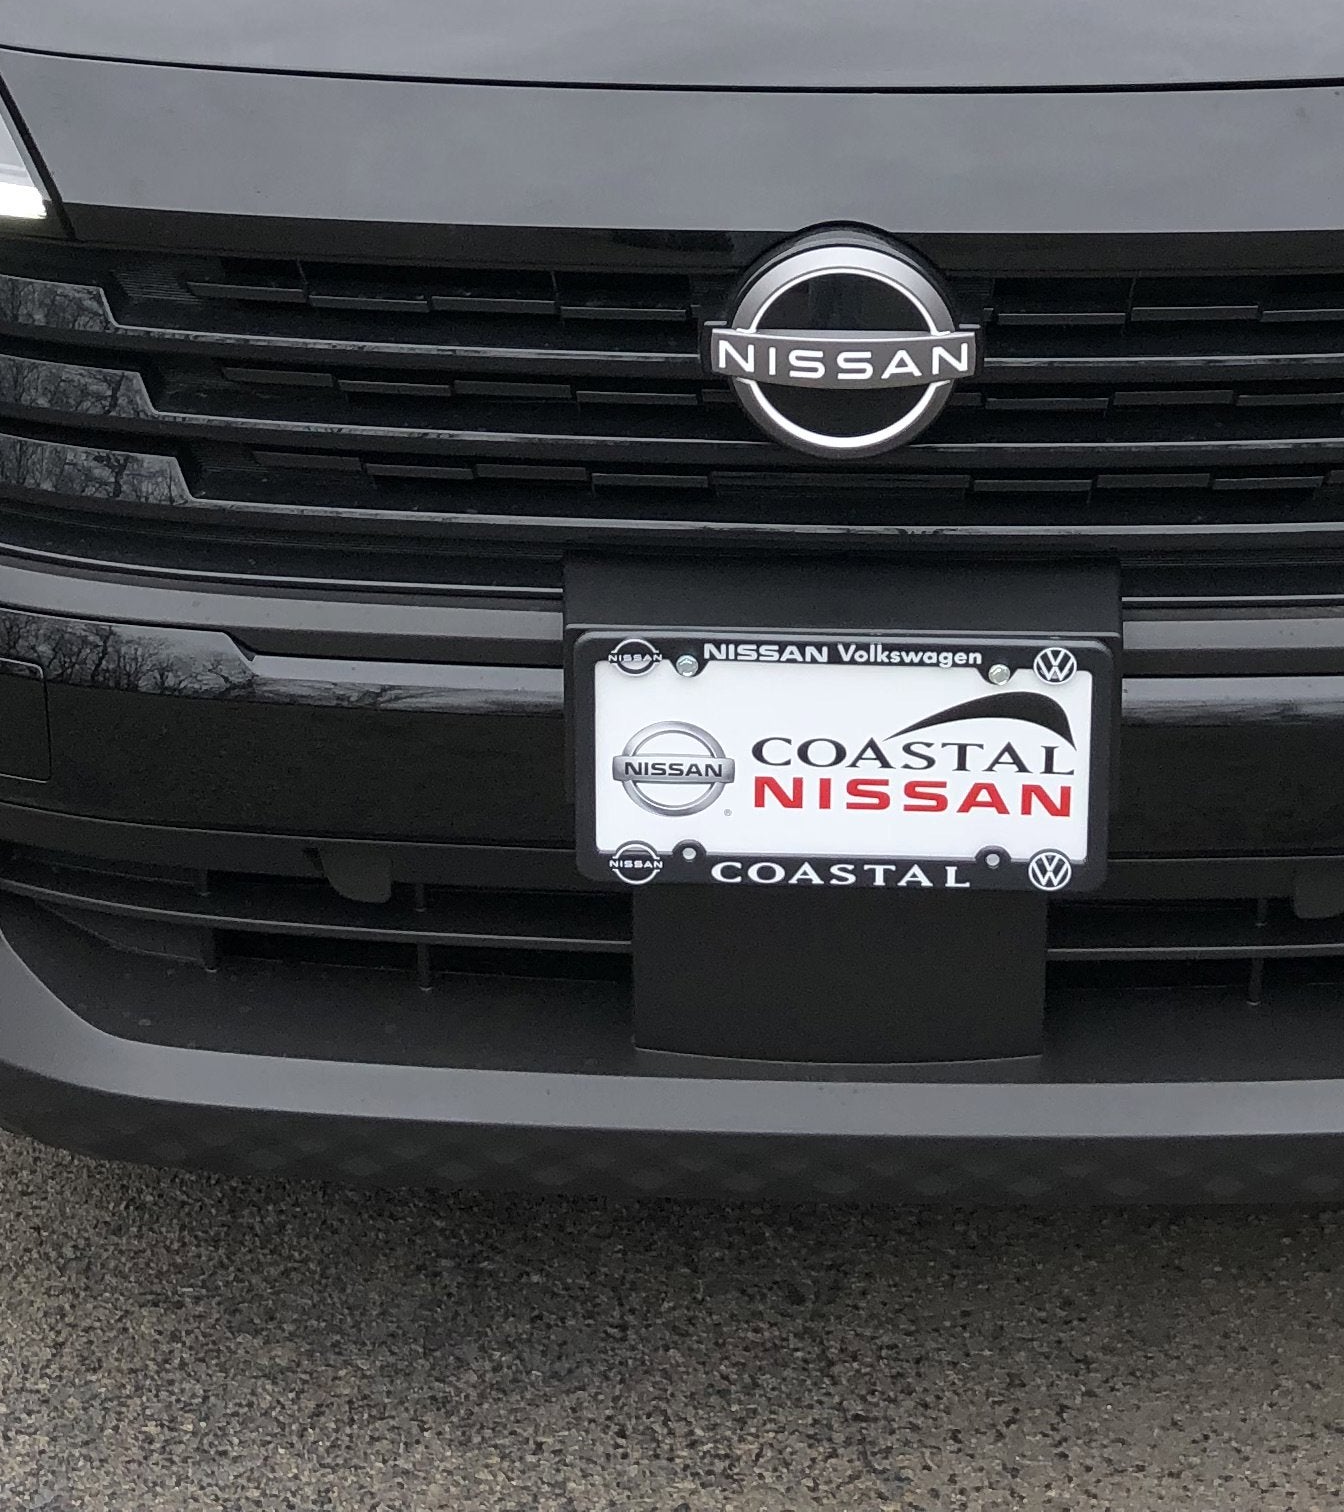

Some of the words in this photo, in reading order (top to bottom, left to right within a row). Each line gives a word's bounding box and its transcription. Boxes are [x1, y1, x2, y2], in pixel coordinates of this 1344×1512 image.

[718, 340, 968, 380] NISSAN
[608, 652, 663, 663] NISSAN
[703, 642, 828, 663] NISSAN
[837, 644, 982, 669] Volkswagen
[624, 761, 723, 778] NISSAN
[751, 737, 1074, 776] COASTAL
[754, 776, 1072, 817] NISSAN
[609, 858, 663, 870] NISSAN
[711, 861, 970, 887] COASTAL
